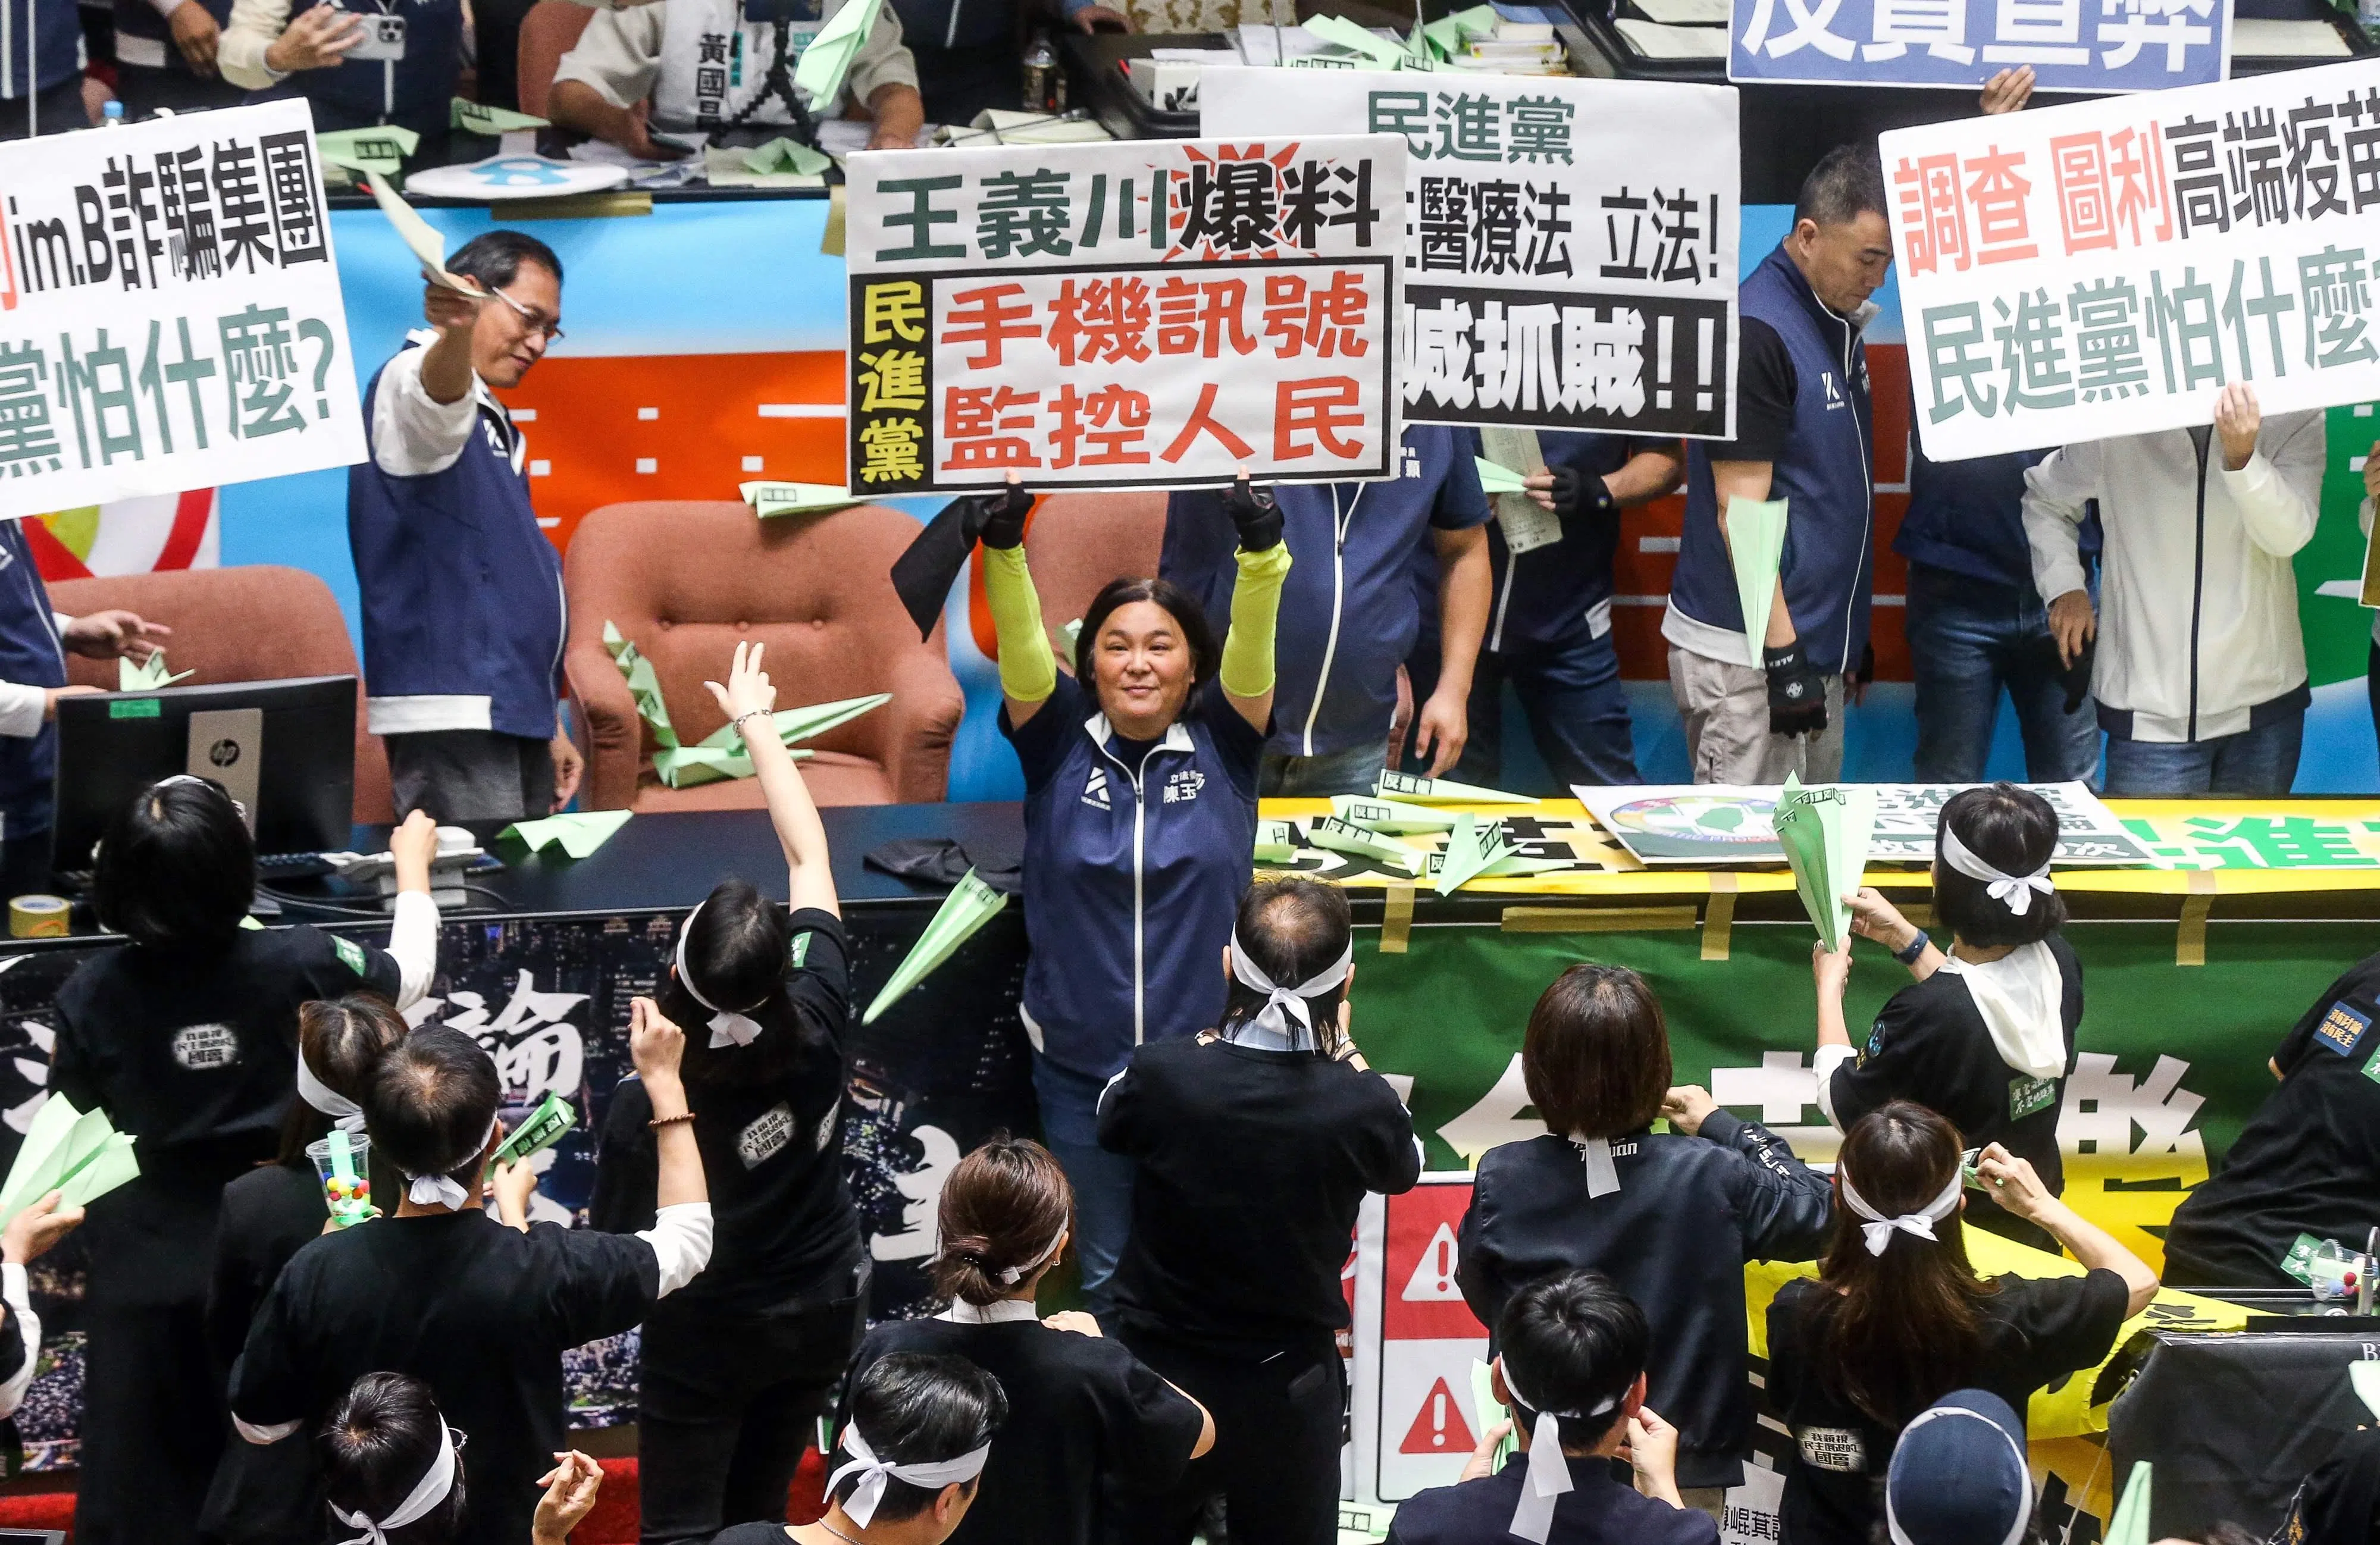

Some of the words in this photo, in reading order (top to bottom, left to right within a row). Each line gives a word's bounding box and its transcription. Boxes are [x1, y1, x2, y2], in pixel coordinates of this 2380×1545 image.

[1368, 90, 1576, 167] 民進黨
[0, 130, 328, 311] im.B詐騙集團
[875, 158, 1380, 262] 王義川爆料
[1405, 176, 1574, 280] 醫療法
[1600, 187, 1718, 286] 立法!
[1893, 144, 2040, 278] 調查
[941, 270, 1368, 369] 手機訊號
[1921, 244, 2380, 425] 民進黨怕什麼
[857, 280, 926, 483] 民進黨
[940, 375, 1366, 471] 監控人民
[1815, 1450, 1850, 1466] 國會
